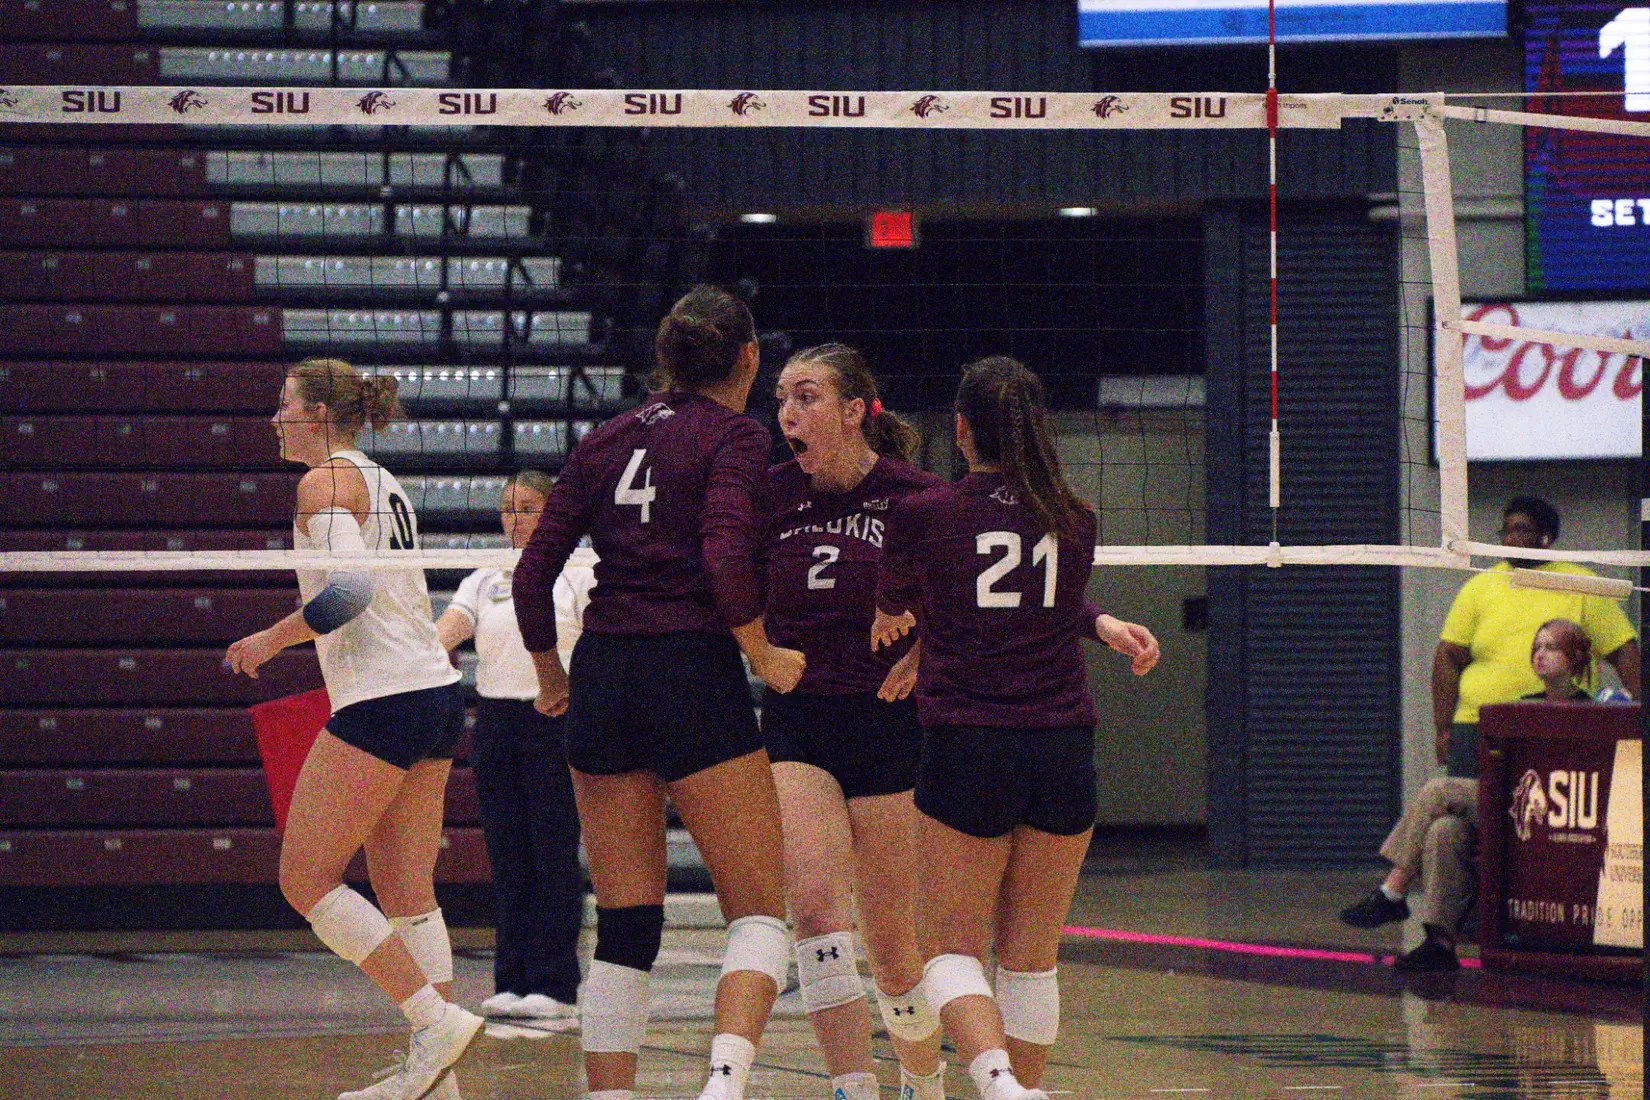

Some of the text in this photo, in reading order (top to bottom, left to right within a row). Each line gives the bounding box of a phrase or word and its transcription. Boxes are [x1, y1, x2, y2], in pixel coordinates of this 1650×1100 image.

[1599, 7, 1650, 112] 1
[61, 90, 122, 114] SIU
[250, 91, 310, 114] SIU
[438, 92, 497, 115] SIU
[624, 93, 682, 115] SIU
[808, 94, 866, 117] SIU
[989, 97, 1048, 119] SIU
[1170, 97, 1227, 119] SIU
[1591, 198, 1650, 227] SET
[614, 448, 656, 523] 4
[807, 545, 840, 590] 2
[975, 530, 1059, 608] 21
[1547, 770, 1599, 829] SIU
[1508, 898, 1565, 924] TRADITION
